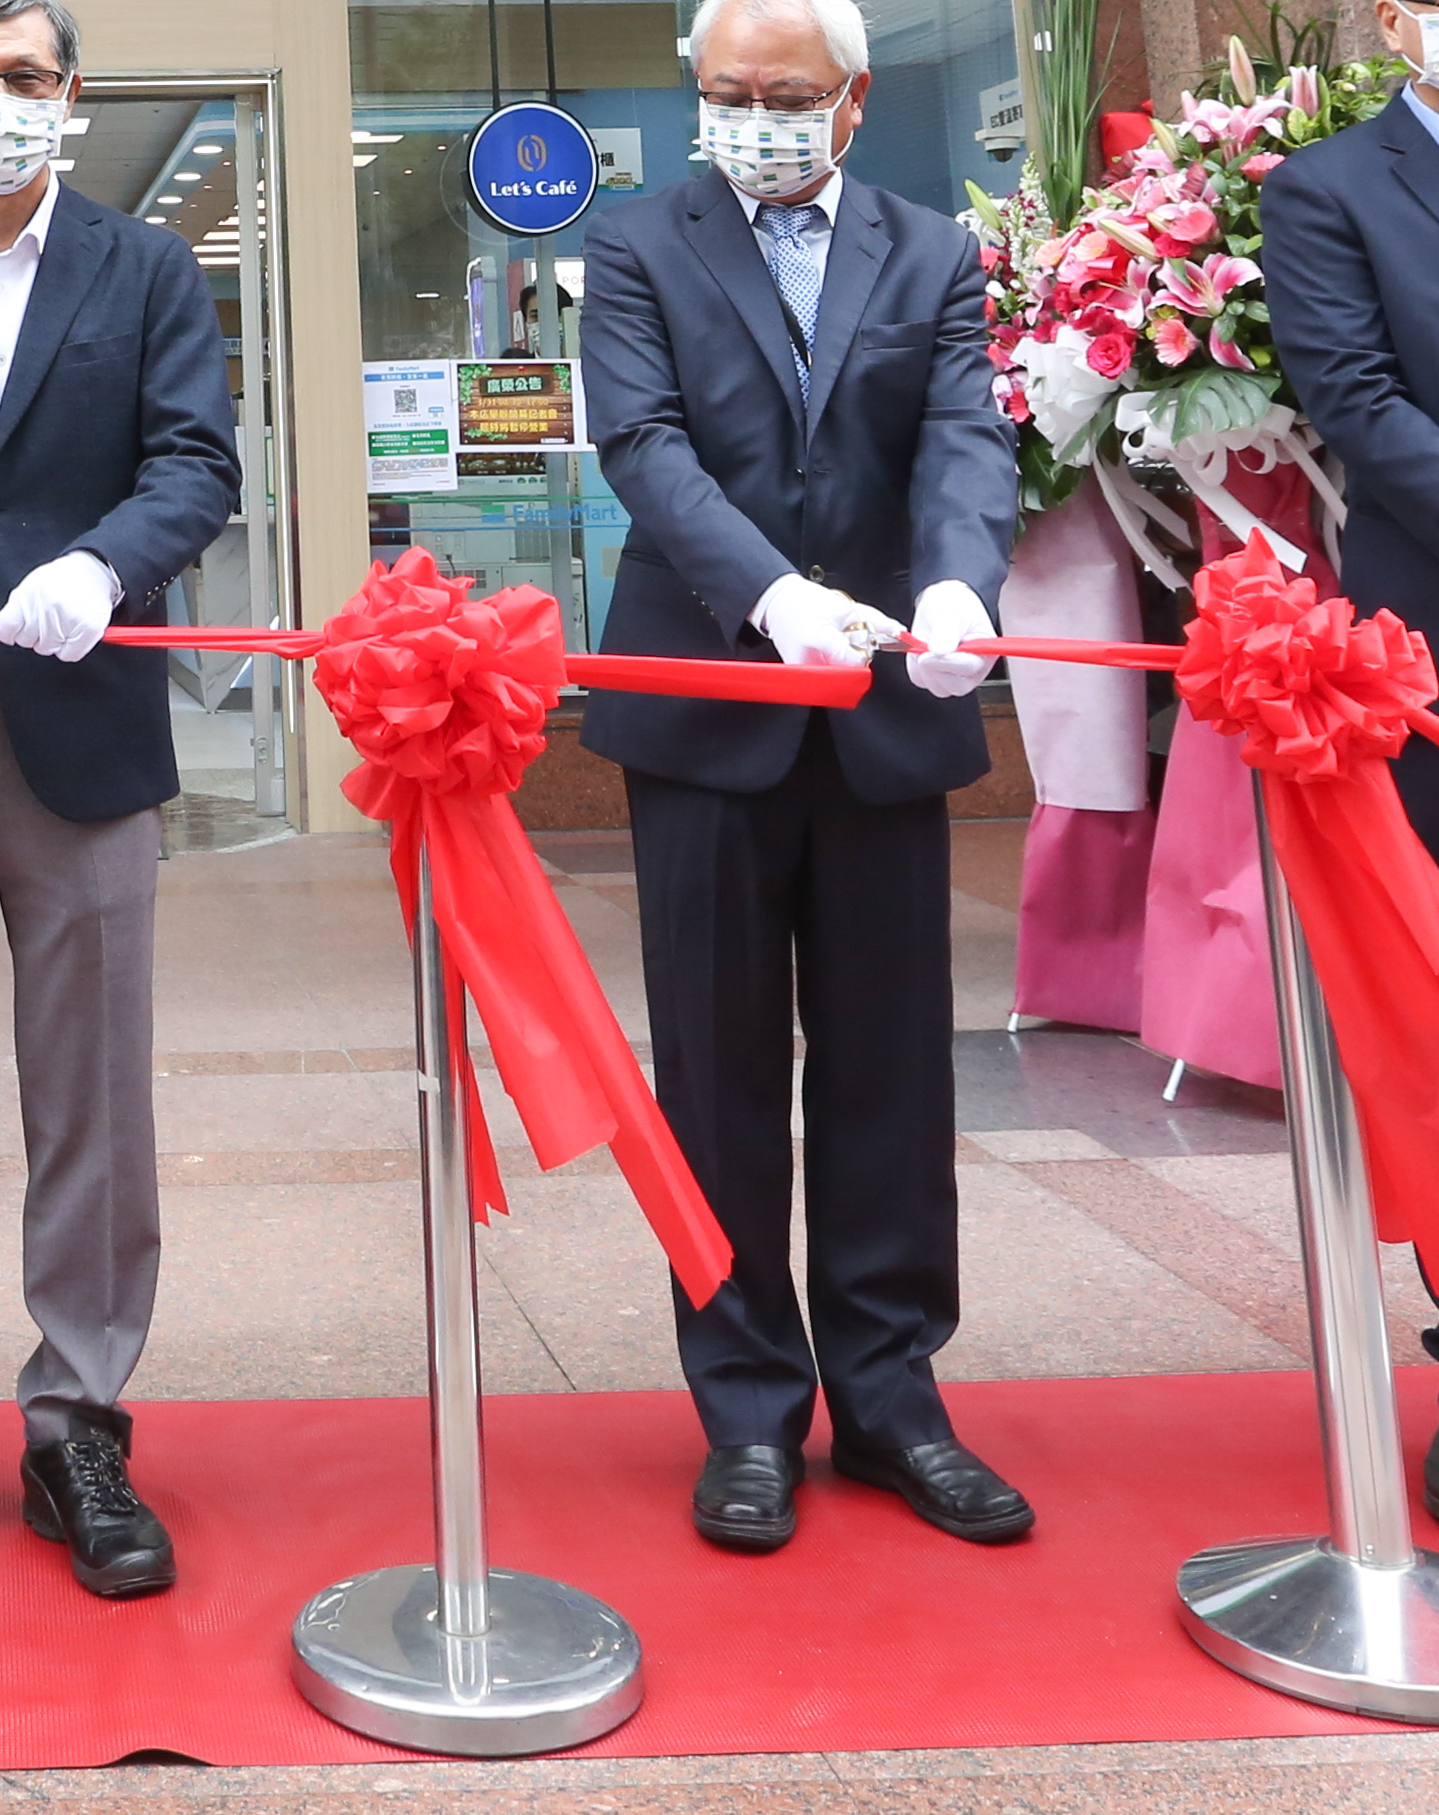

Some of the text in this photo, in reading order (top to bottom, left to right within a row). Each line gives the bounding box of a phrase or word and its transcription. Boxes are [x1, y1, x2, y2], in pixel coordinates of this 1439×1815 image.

[490, 180, 578, 197] Let's Café
[513, 503, 617, 523] FamilyMart
